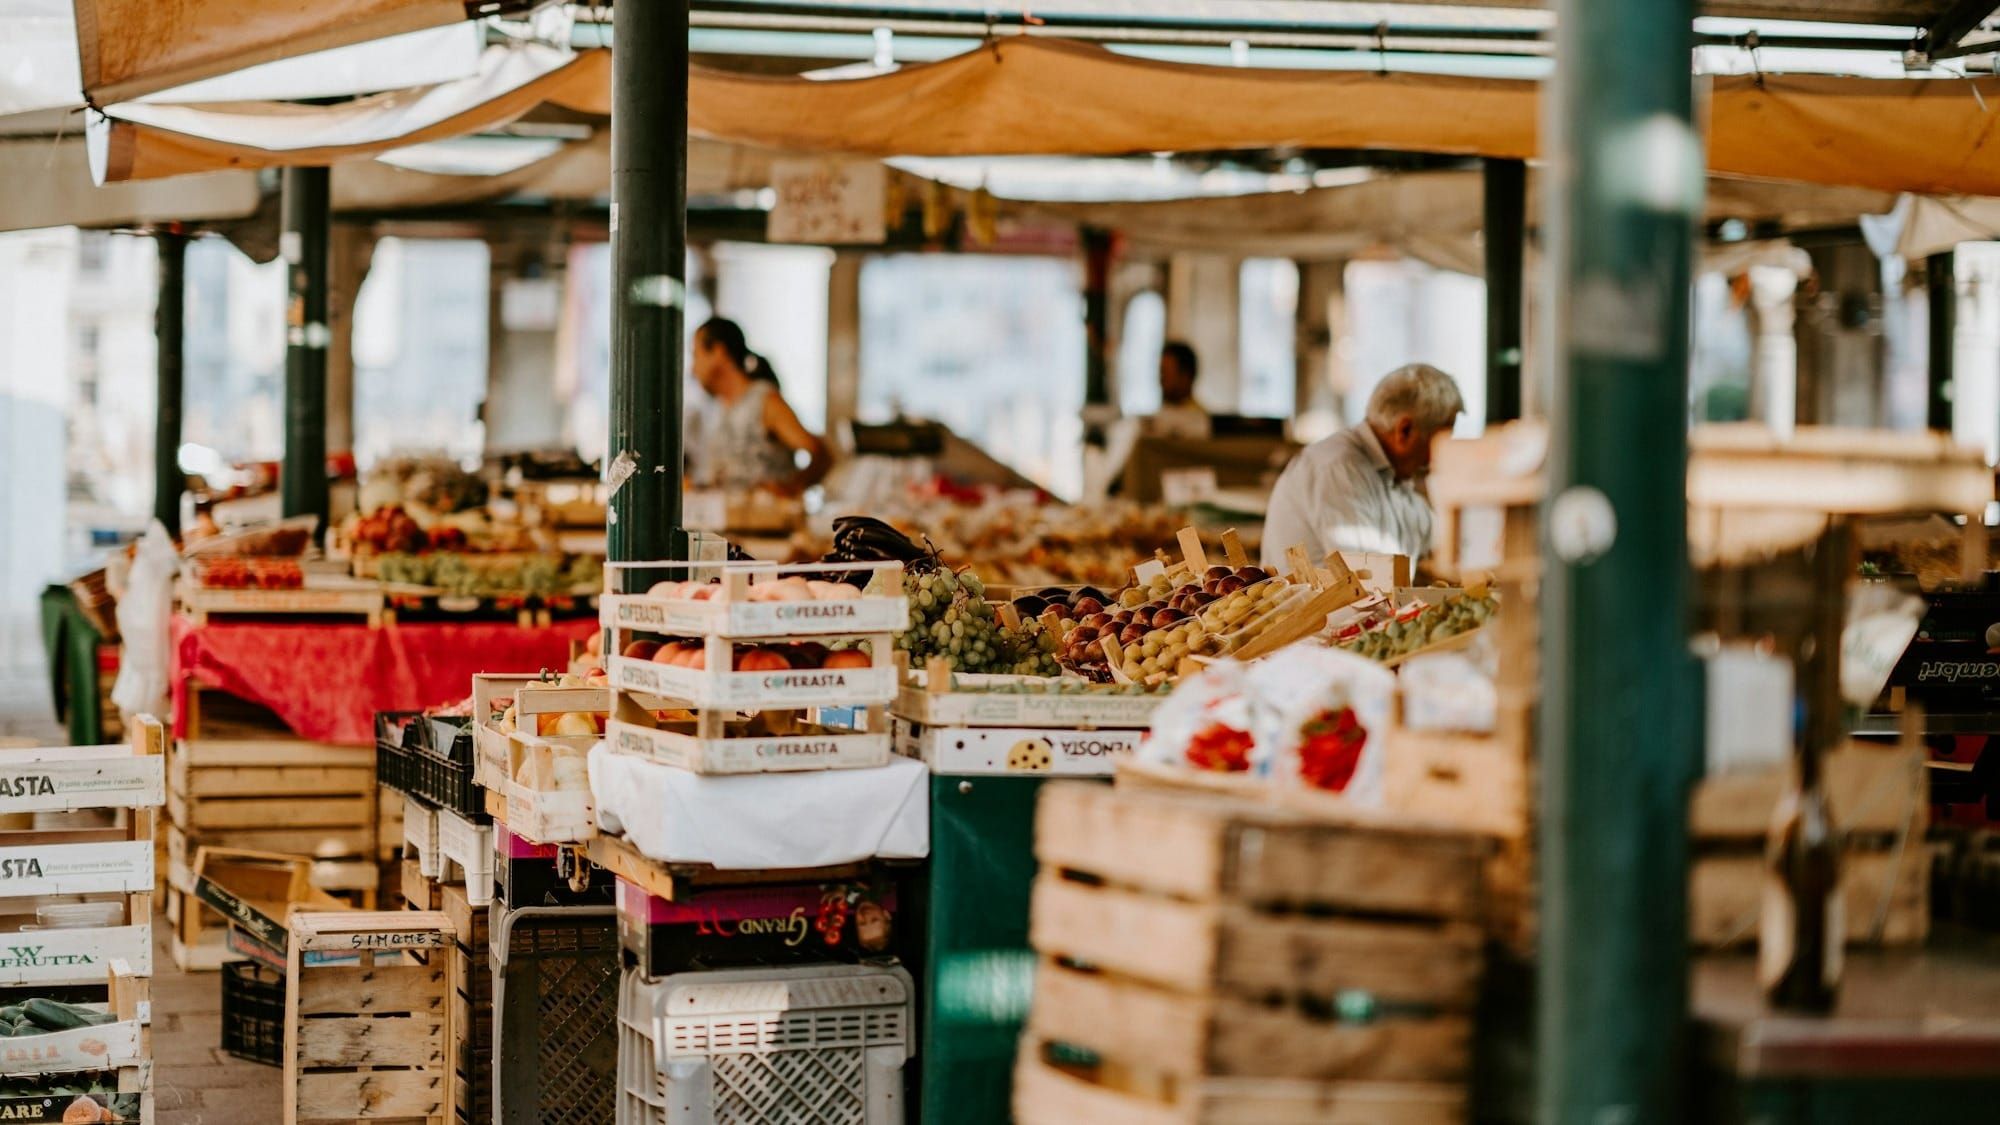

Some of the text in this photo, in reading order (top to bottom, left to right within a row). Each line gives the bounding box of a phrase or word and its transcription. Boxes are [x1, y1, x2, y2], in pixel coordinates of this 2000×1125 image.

[1917, 661, 2000, 683] embri
[0, 858, 43, 879] STA
[0, 954, 94, 968] FRUTTA
[0, 1103, 44, 1119] ARE
